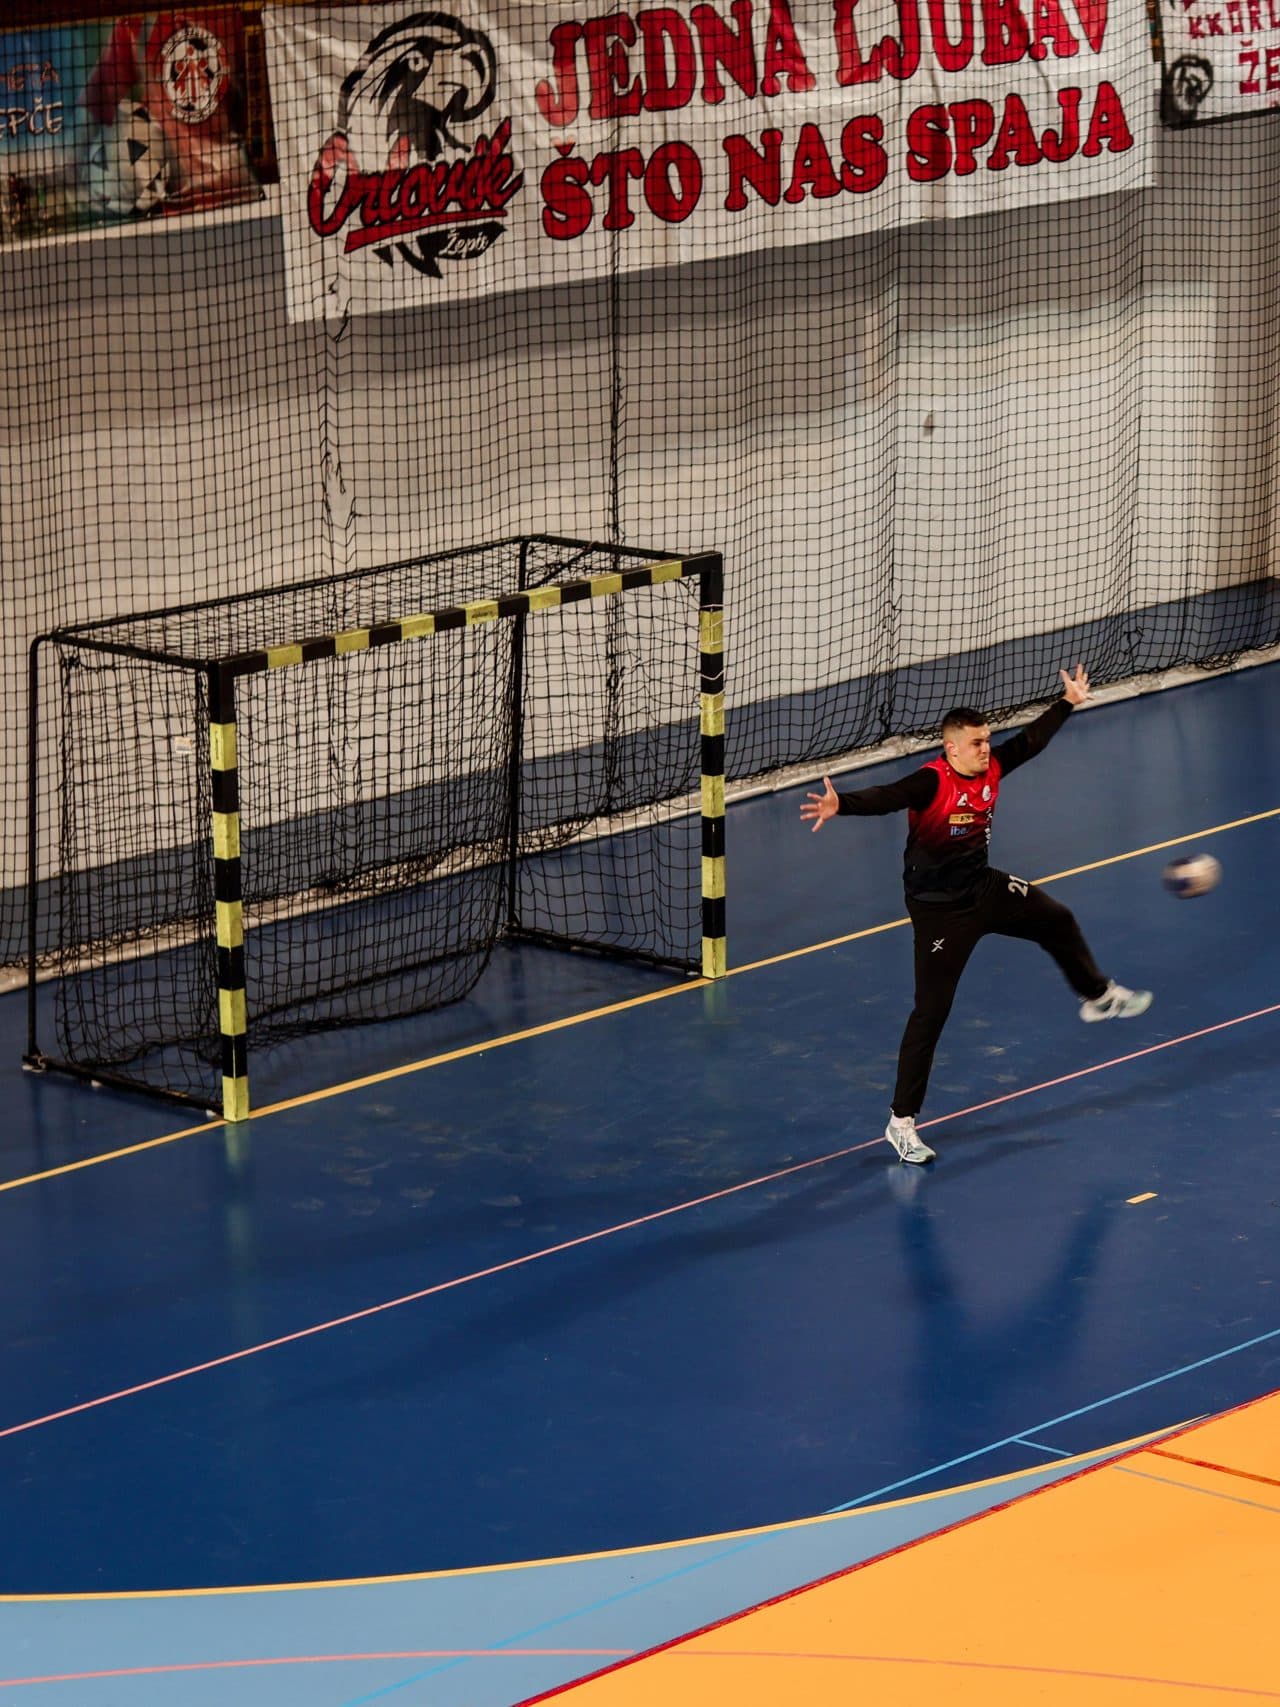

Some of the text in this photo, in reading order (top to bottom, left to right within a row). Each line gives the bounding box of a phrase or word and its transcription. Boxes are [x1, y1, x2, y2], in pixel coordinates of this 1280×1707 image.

[535, 0, 1110, 127] JEDNA LJUBAV
[540, 81, 1134, 241] ŠTO NAS SPAJA
[1007, 874, 1029, 898] 21
